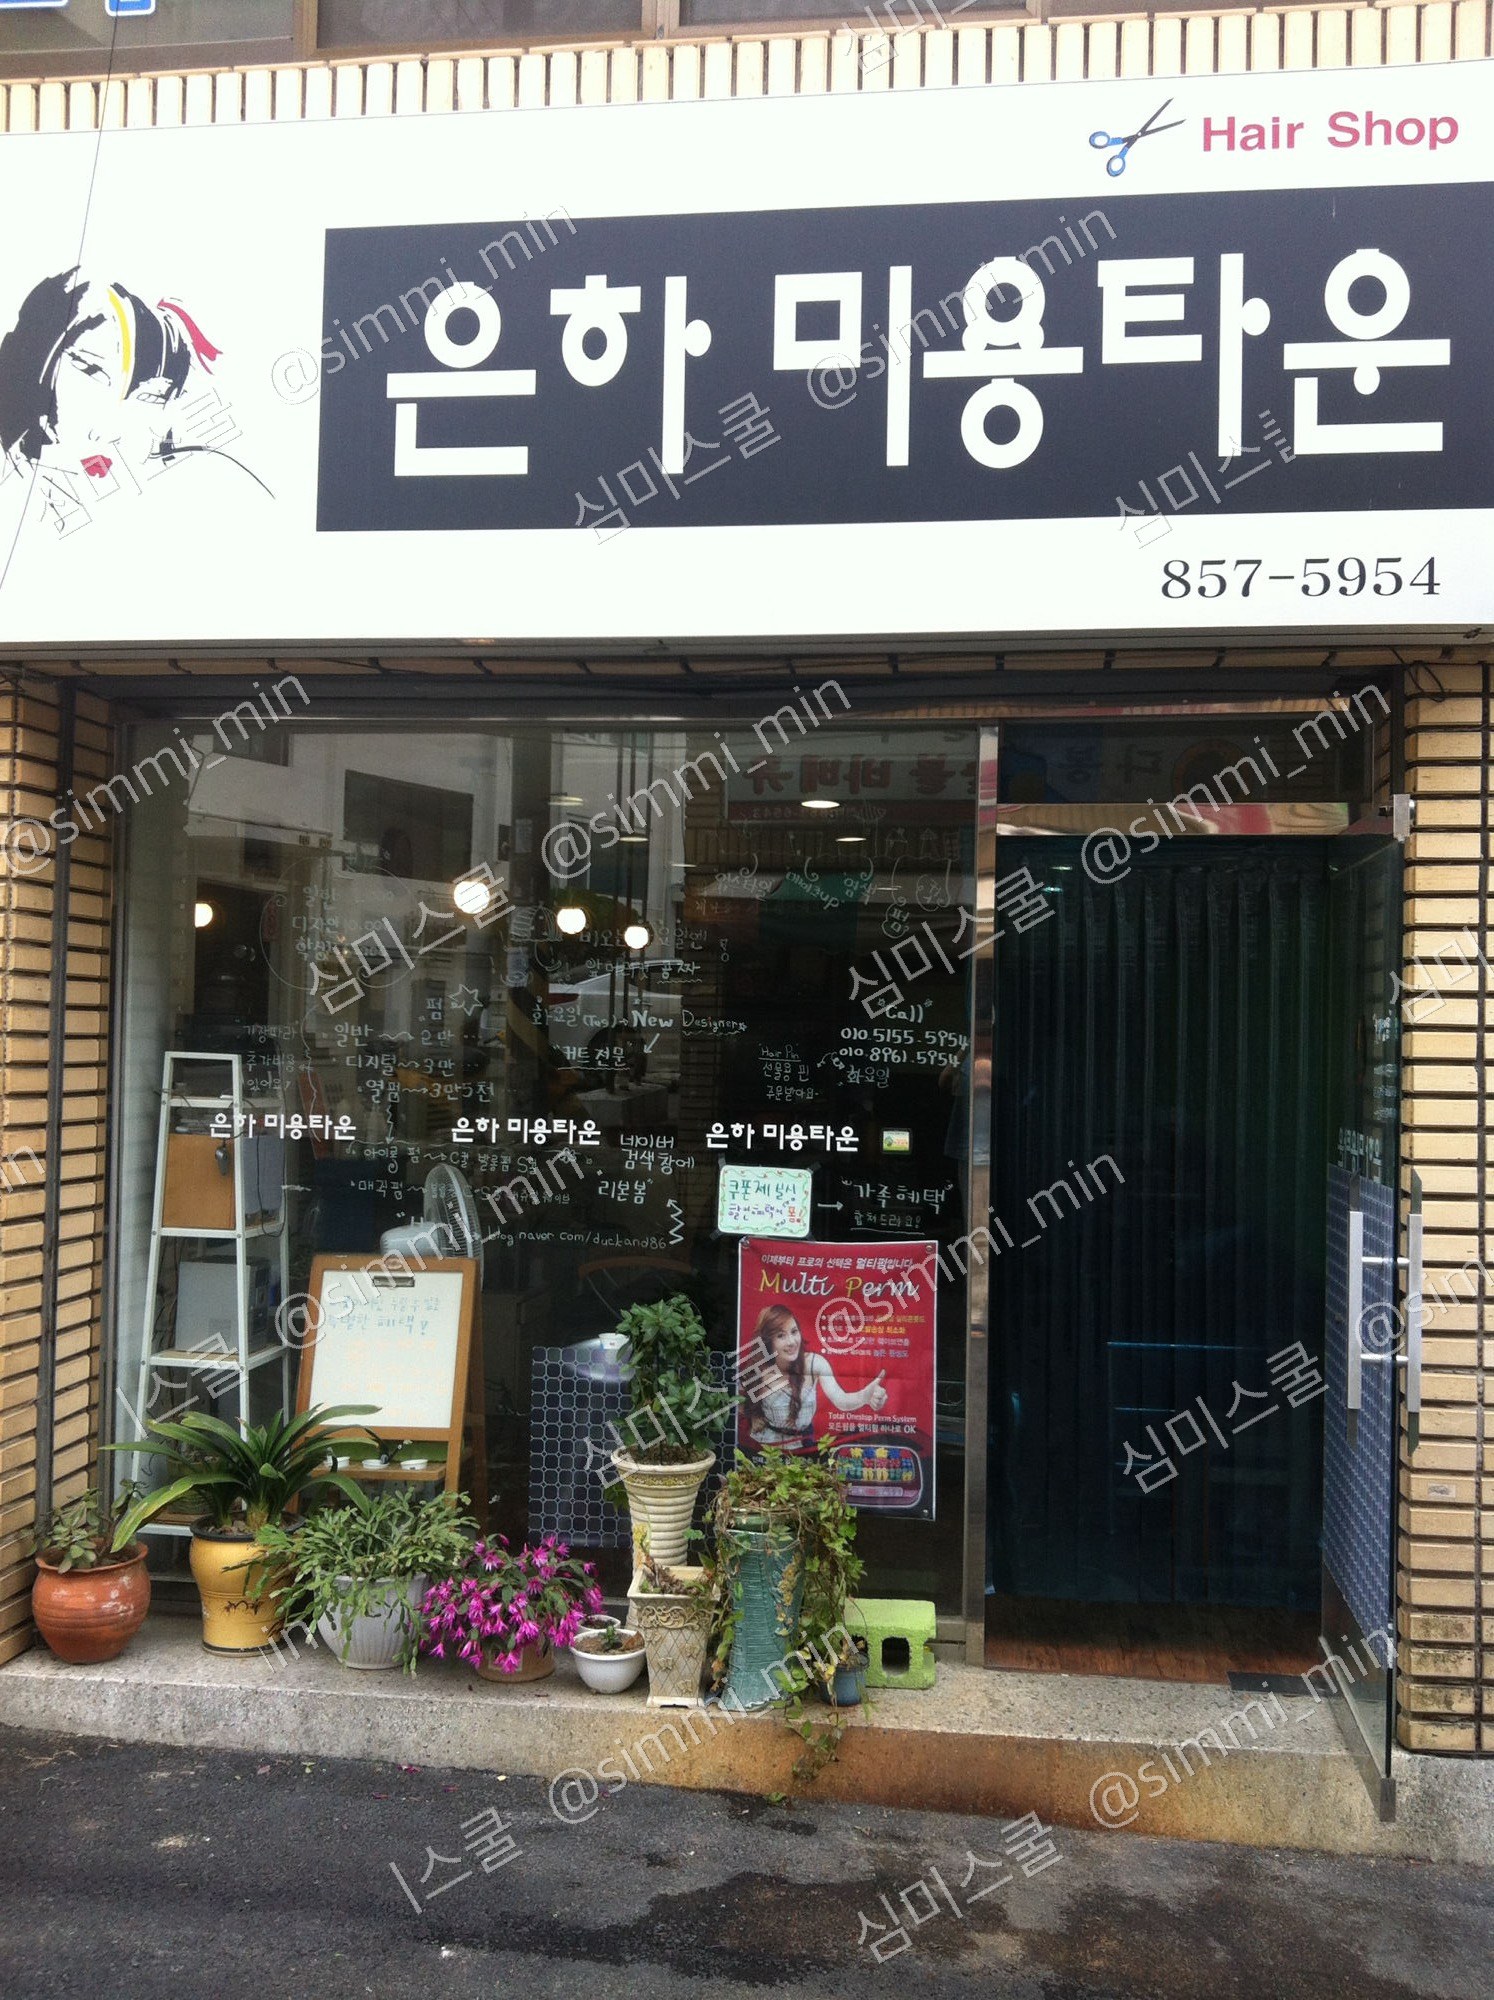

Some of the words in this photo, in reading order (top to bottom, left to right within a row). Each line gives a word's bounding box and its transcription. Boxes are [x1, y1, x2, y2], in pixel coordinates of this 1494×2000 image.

[1202, 116, 1305, 152] Hair
[1327, 110, 1459, 151] Shop
[387, 273, 712, 477] 은하
[772, 247, 1452, 470] 미용타운
[1160, 556, 1442, 600] 857-5954
[631, 1009, 674, 1029] New
[884, 1003, 925, 1024] Call
[334, 1022, 375, 1047] 일반
[346, 1055, 397, 1078] 디지털
[846, 1064, 890, 1089] 화요일
[209, 1112, 257, 1139] 은하
[264, 1113, 357, 1141] 미용타운
[451, 1117, 500, 1144] 은하
[507, 1117, 601, 1146] 미용타운
[705, 1122, 755, 1150] 은하
[762, 1123, 859, 1152] 미용타운
[620, 1133, 674, 1149] 네이버
[760, 1269, 835, 1296] Multi
[845, 1276, 920, 1298] Perm
[829, 1411, 846, 1421] Total
[874, 1414, 892, 1422] Perm
[892, 1415, 917, 1424] System
[904, 1425, 917, 1434] OK
